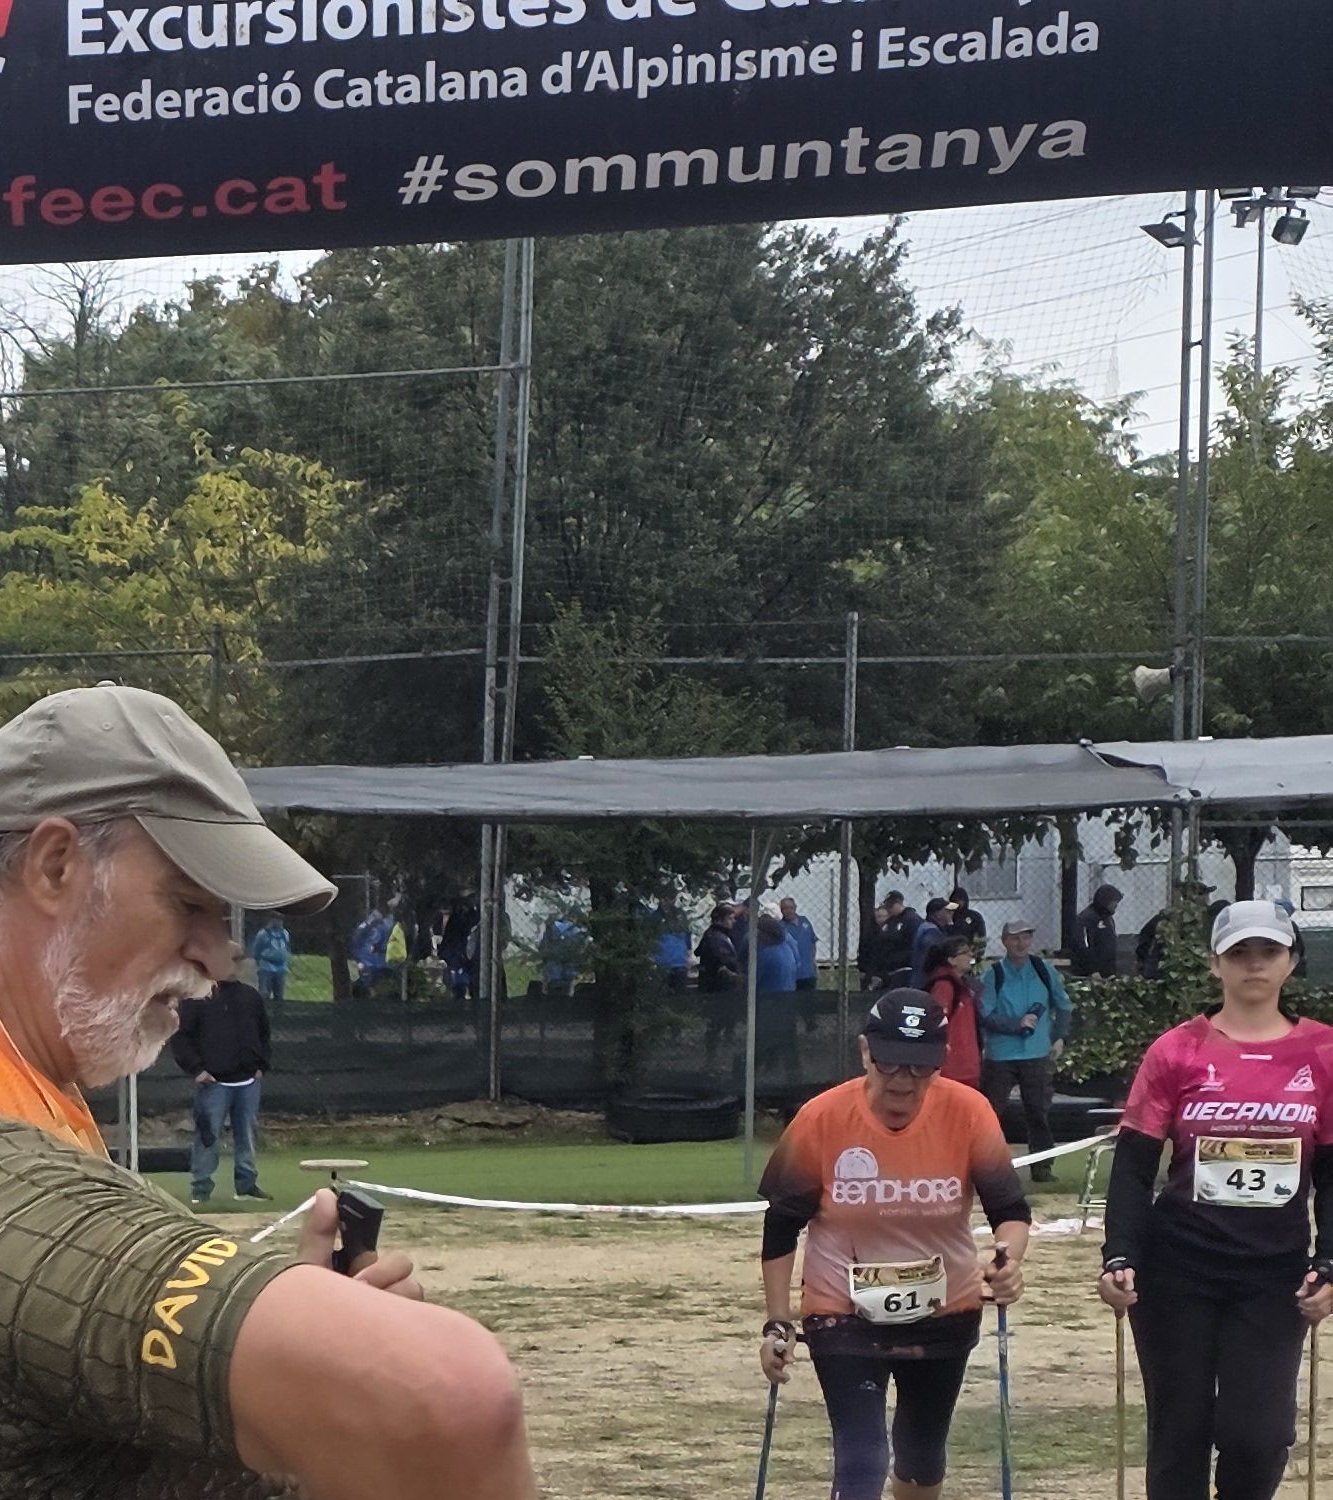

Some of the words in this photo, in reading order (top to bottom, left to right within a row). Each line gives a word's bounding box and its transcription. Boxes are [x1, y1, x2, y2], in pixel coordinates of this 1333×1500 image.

[68, 71, 300, 125] Federació
[313, 61, 528, 110] Catalana
[541, 39, 838, 99] d'Alpinisme
[850, 29, 864, 72] i
[877, 11, 1100, 70] Escalada
[397, 119, 1088, 206] #sommuntanya
[1226, 1168, 1267, 1191] 43
[141, 1236, 239, 1370] DAVID
[884, 1290, 921, 1313] 61
